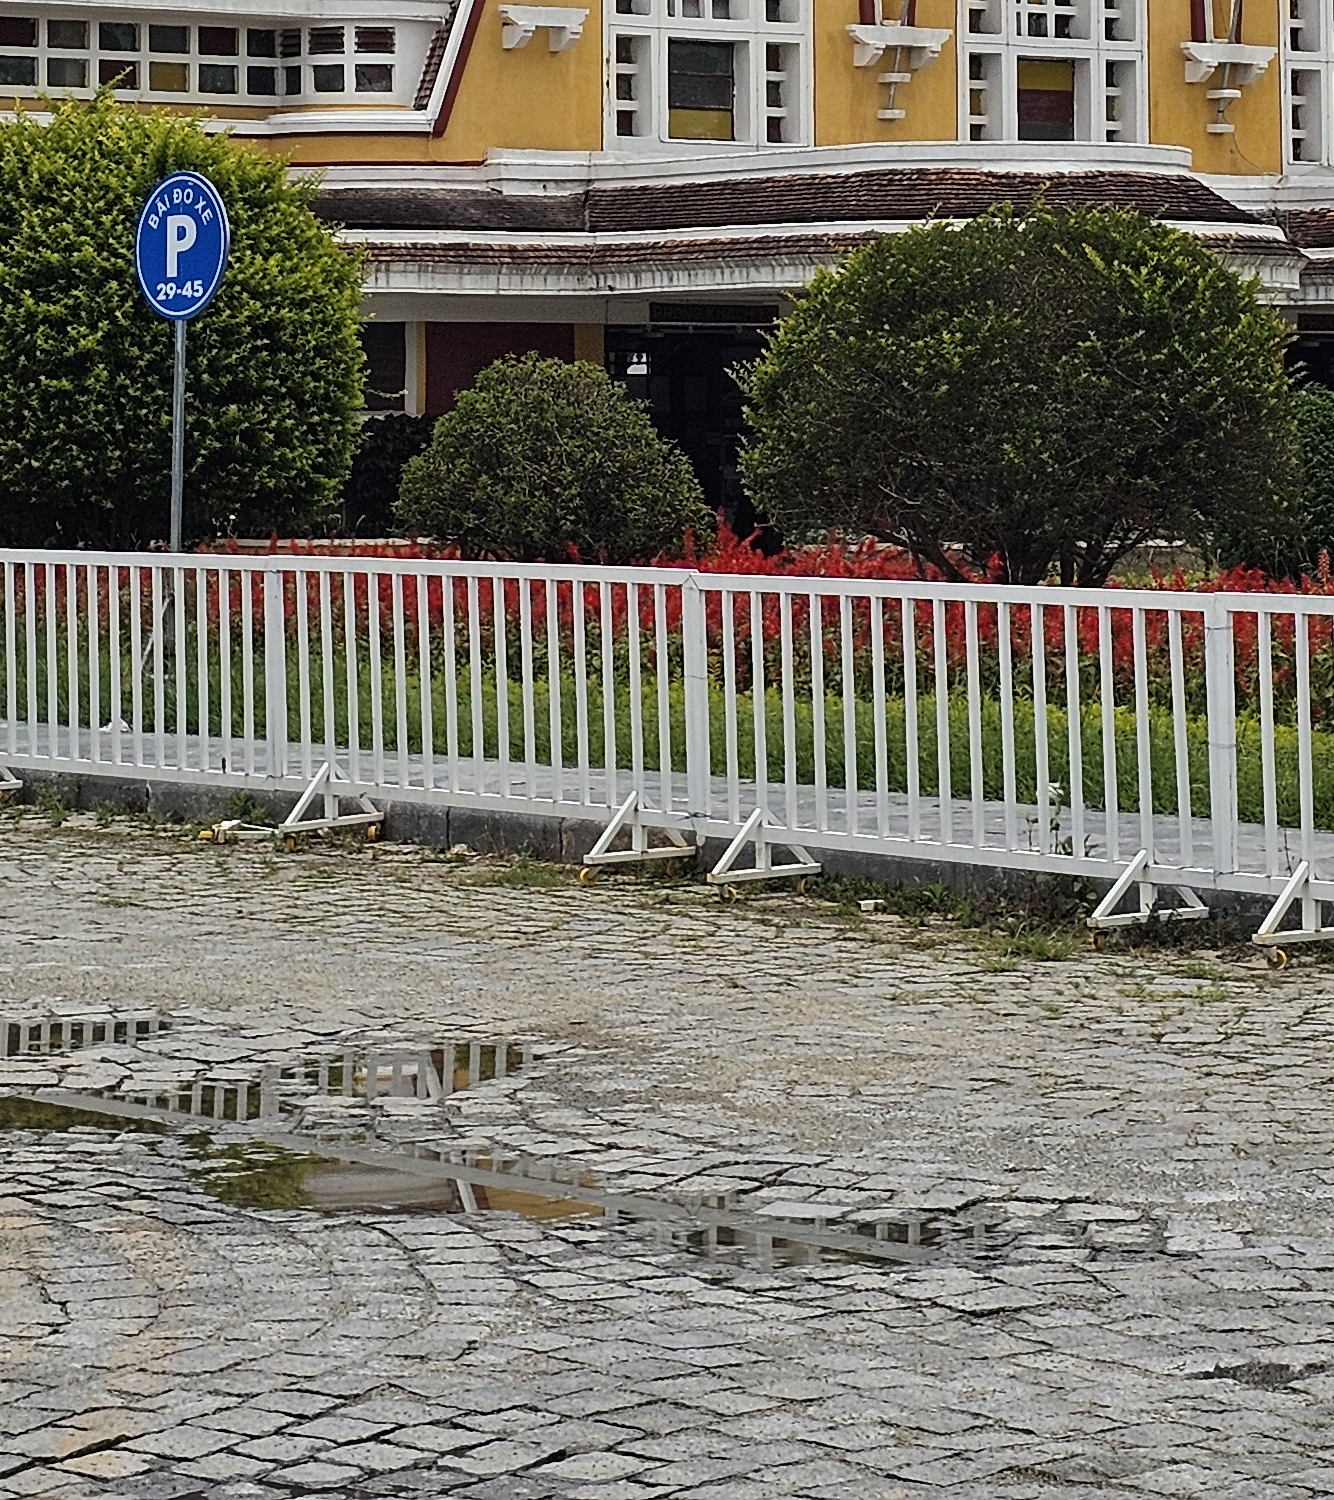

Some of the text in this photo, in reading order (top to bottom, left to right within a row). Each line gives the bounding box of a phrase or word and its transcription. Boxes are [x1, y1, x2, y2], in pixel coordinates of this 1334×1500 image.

[193, 195, 214, 226] XE
[166, 214, 198, 278] P
[156, 279, 204, 301] 29-45
